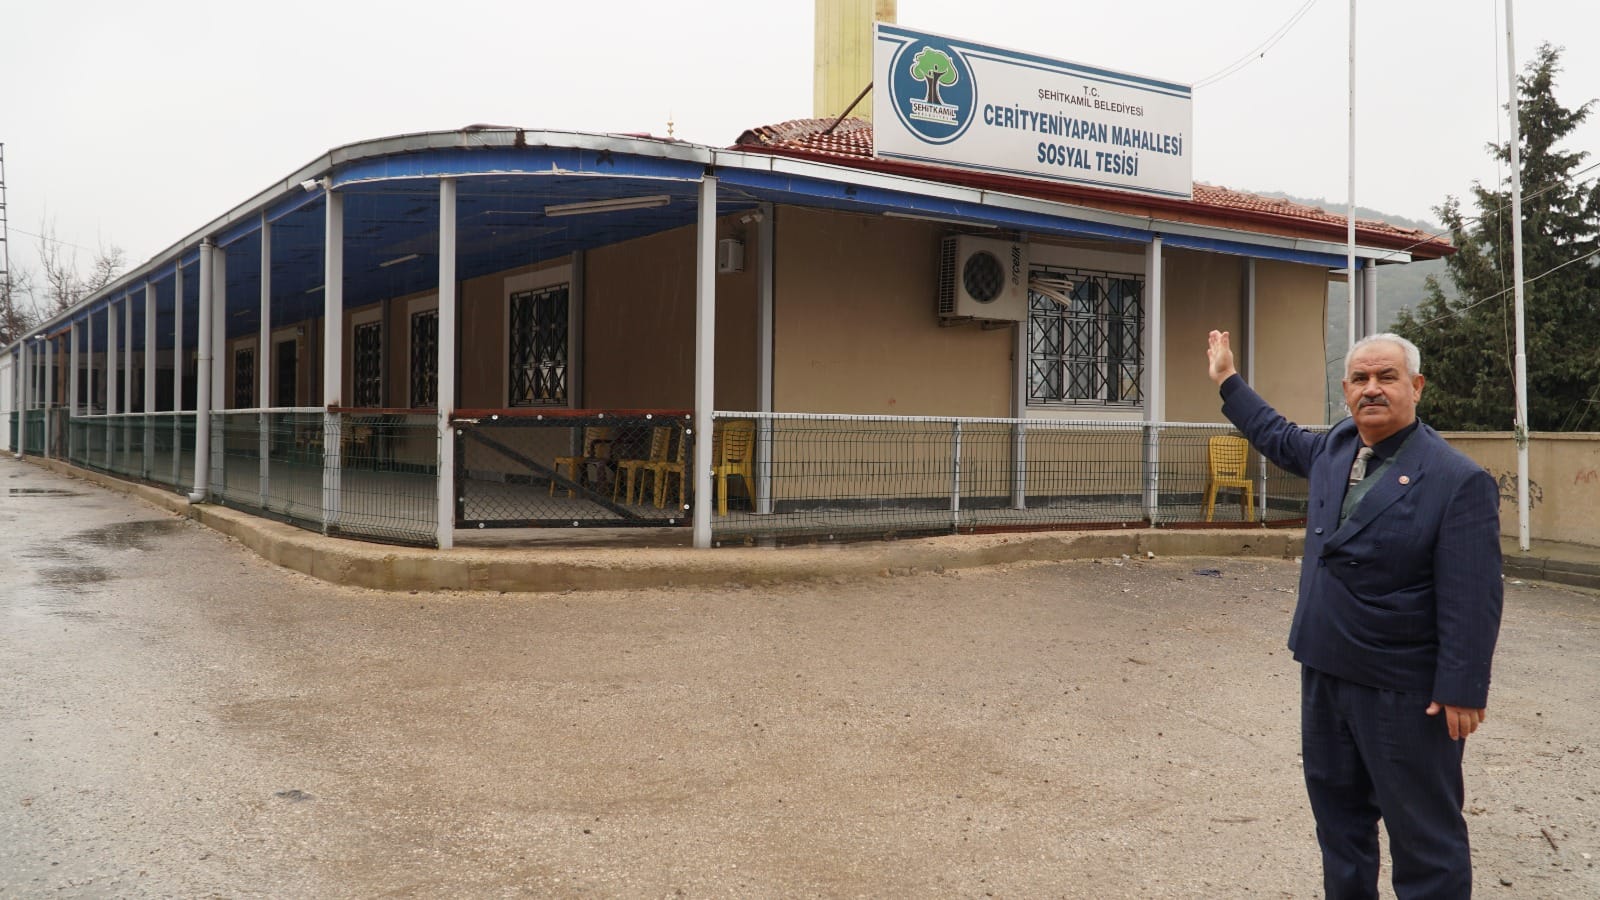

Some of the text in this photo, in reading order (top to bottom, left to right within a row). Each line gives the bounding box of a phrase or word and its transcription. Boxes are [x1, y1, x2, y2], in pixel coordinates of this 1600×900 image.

[1038, 88, 1144, 117] ŞEHİTKAMİL BELEDİYESİ
[1083, 86, 1100, 97] T.C.
[984, 103, 1183, 157] CERİTYENİYAPAN MAHALLESİ
[1037, 142, 1138, 176] SOSYAL TESİSİ
